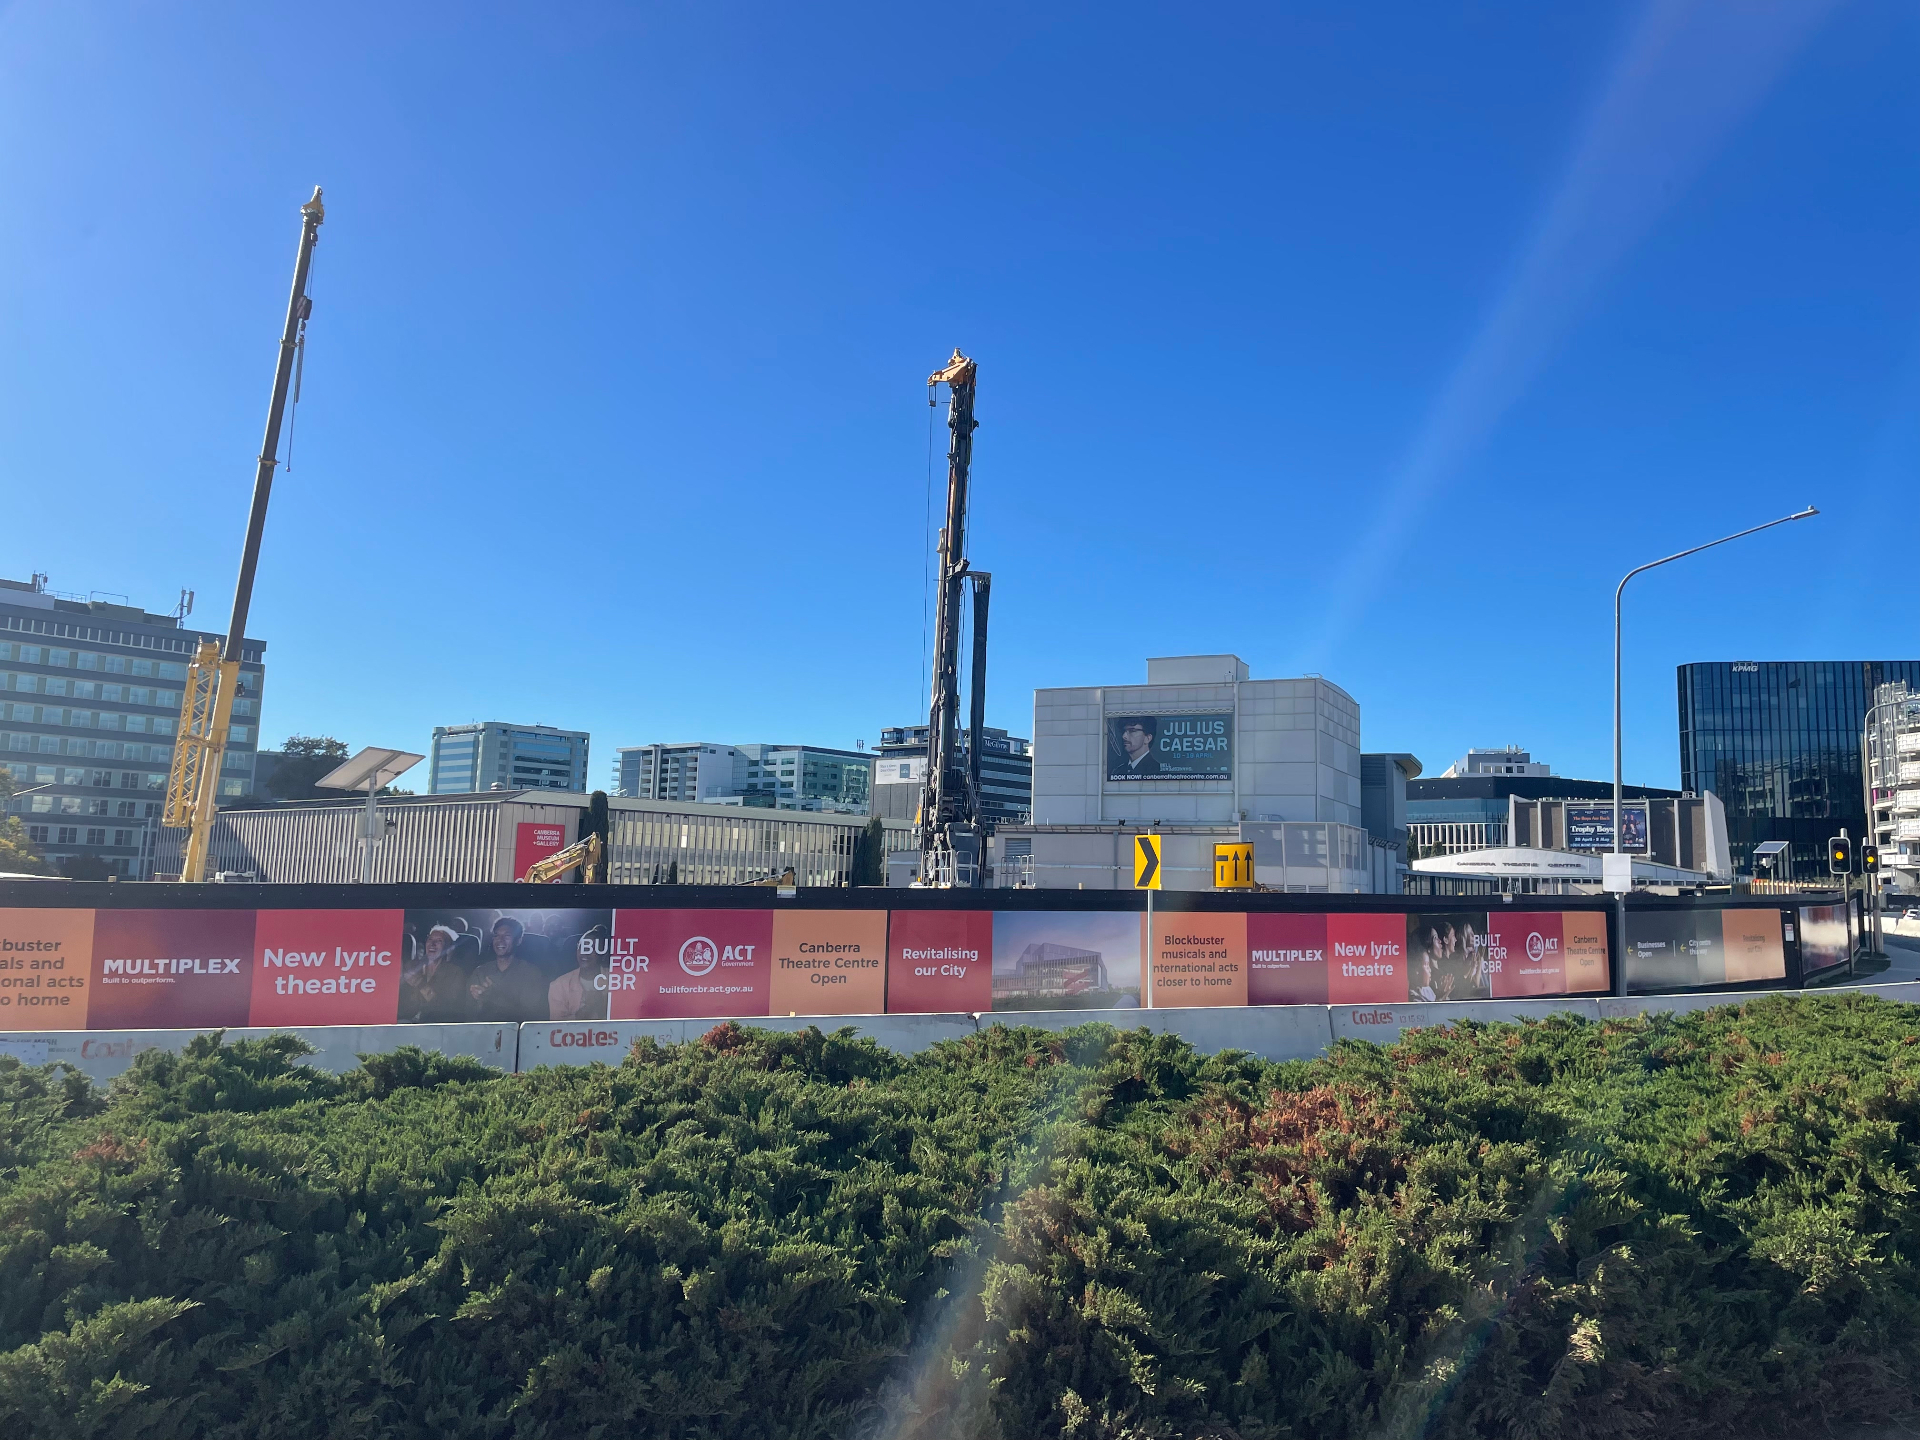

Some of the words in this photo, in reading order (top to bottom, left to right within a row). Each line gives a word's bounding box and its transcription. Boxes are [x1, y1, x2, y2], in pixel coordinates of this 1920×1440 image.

[1164, 720, 1224, 736] JULIUS
[1160, 737, 1228, 752] CAESAR
[1570, 825, 1595, 835] Trophy
[1597, 826, 1614, 834] Boys
[580, 938, 638, 954] BUILT
[1164, 935, 1225, 945] Blockbuster
[1473, 934, 1501, 947] BUILT
[1545, 938, 1558, 950] ACT
[1574, 935, 1598, 944] Canberra
[722, 945, 755, 960] ACT
[799, 942, 860, 953] Canberra
[903, 947, 978, 961] Revitalising
[1162, 949, 1206, 959] musicals
[1208, 949, 1227, 959] and
[1335, 942, 1366, 956] New
[1370, 941, 1400, 960] lyric
[1488, 947, 1507, 959] FOR
[1566, 947, 1587, 955] Theatre
[264, 948, 326, 968] New
[334, 946, 392, 971] lyric
[1252, 950, 1322, 962] MULTIPLEX
[1638, 950, 1652, 959] Open
[30, 957, 64, 970] and
[103, 959, 240, 974] MULTIPLEX
[609, 956, 649, 972] FOR
[779, 958, 830, 968] Theatre
[834, 958, 879, 968] Centre
[1154, 962, 1215, 973] nternational
[1218, 963, 1238, 972] acts
[1342, 962, 1394, 977] theatre
[1481, 960, 1502, 973] CBR
[1580, 959, 1594, 968] Open
[914, 967, 937, 976] our
[940, 964, 966, 978] City
[47, 976, 84, 988] acts
[275, 974, 376, 994] theatre
[594, 974, 636, 991] CBR
[810, 973, 846, 986] Open
[1157, 977, 1187, 987] closer
[1190, 978, 1200, 986] to
[1204, 976, 1232, 986] home
[659, 986, 753, 994] builtforcbr.act.gov.au
[18, 993, 70, 1006] home
[1352, 1010, 1394, 1025] Coates
[550, 1029, 618, 1047] Coates
